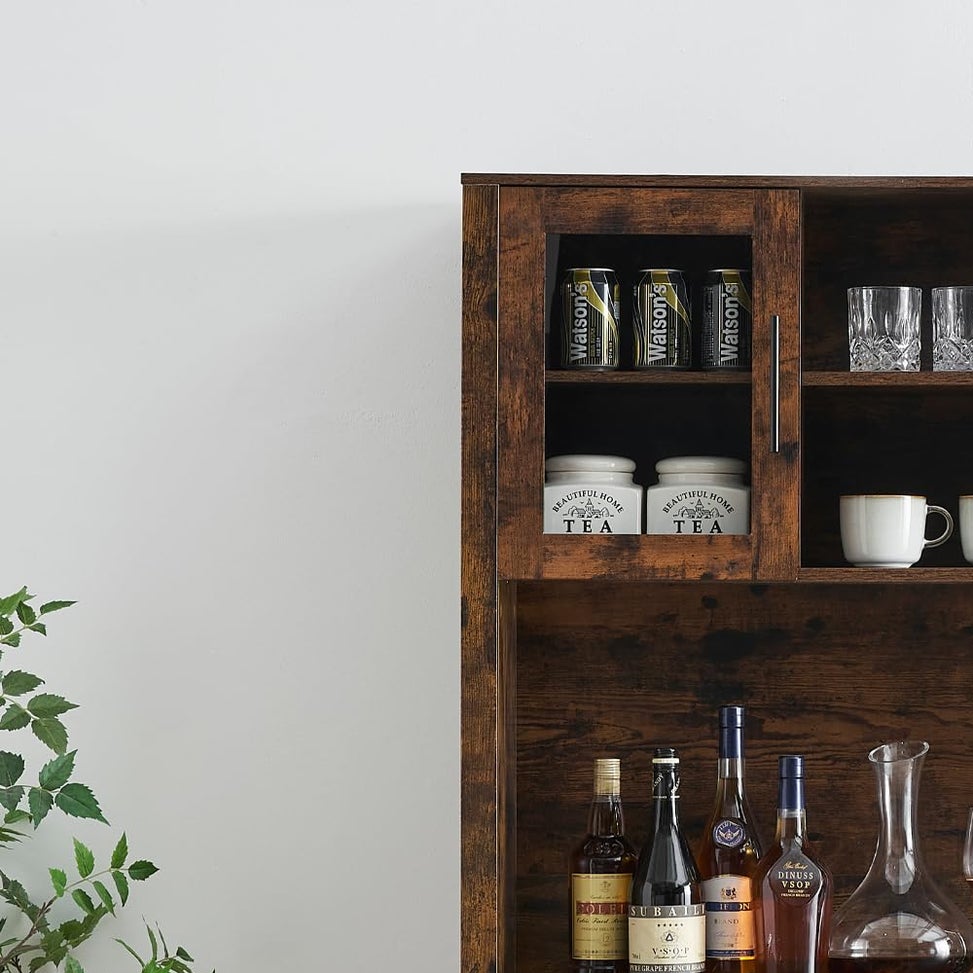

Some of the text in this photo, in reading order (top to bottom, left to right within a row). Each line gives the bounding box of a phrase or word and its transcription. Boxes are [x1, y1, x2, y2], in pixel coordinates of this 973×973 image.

[570, 282, 588, 362] Watson's
[649, 283, 667, 363] Watson's
[720, 283, 739, 363] Watson's
[552, 490, 625, 514] BEAUTIFUL HOME
[662, 490, 735, 514] BEAUTIFUL HOME
[563, 519, 613, 533] TEA
[673, 520, 723, 534] TEA
[778, 871, 814, 880] DINUSS
[781, 880, 811, 889] VSOP
[641, 964, 664, 972] GRAPE
[664, 964, 691, 972] FRENCH
